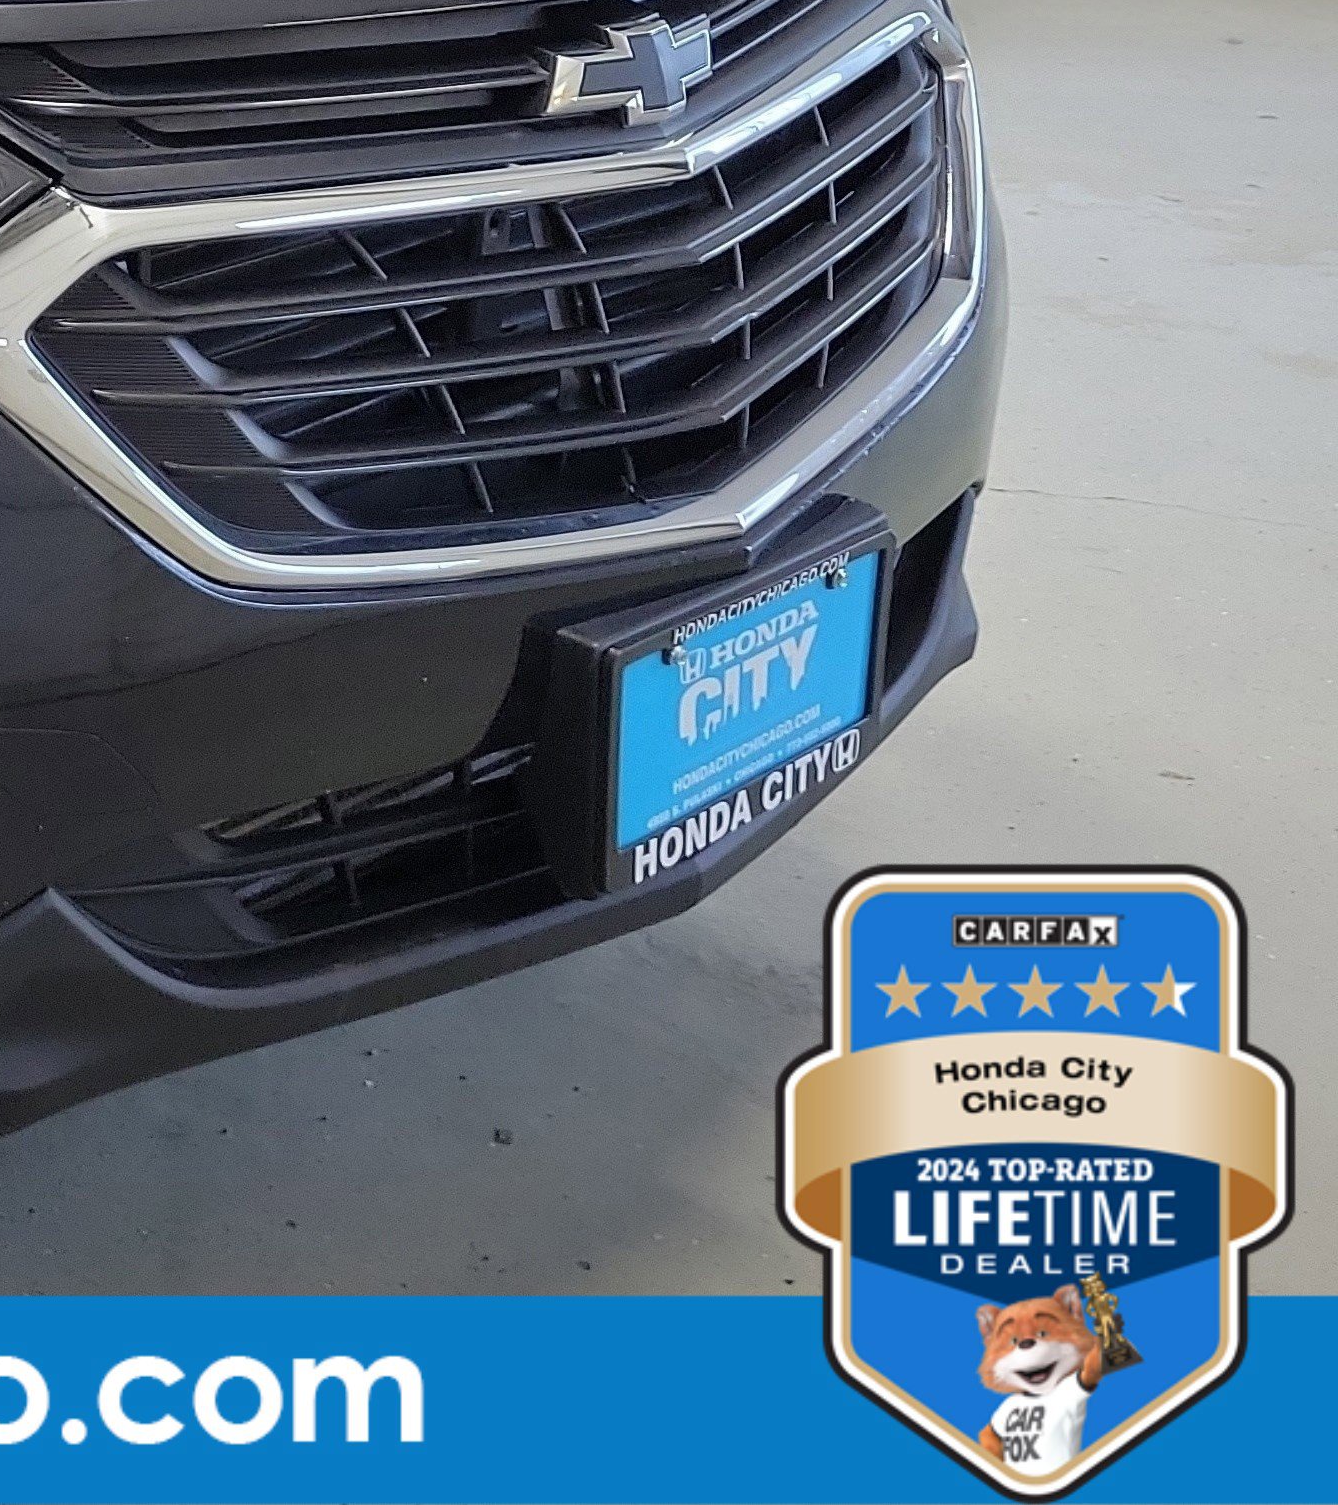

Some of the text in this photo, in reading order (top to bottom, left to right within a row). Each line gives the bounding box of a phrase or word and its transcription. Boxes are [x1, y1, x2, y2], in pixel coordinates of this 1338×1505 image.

[679, 623, 819, 747] CITY
[709, 599, 821, 670] HONDA
[634, 789, 753, 885] HONDA
[761, 741, 832, 811] CITY
